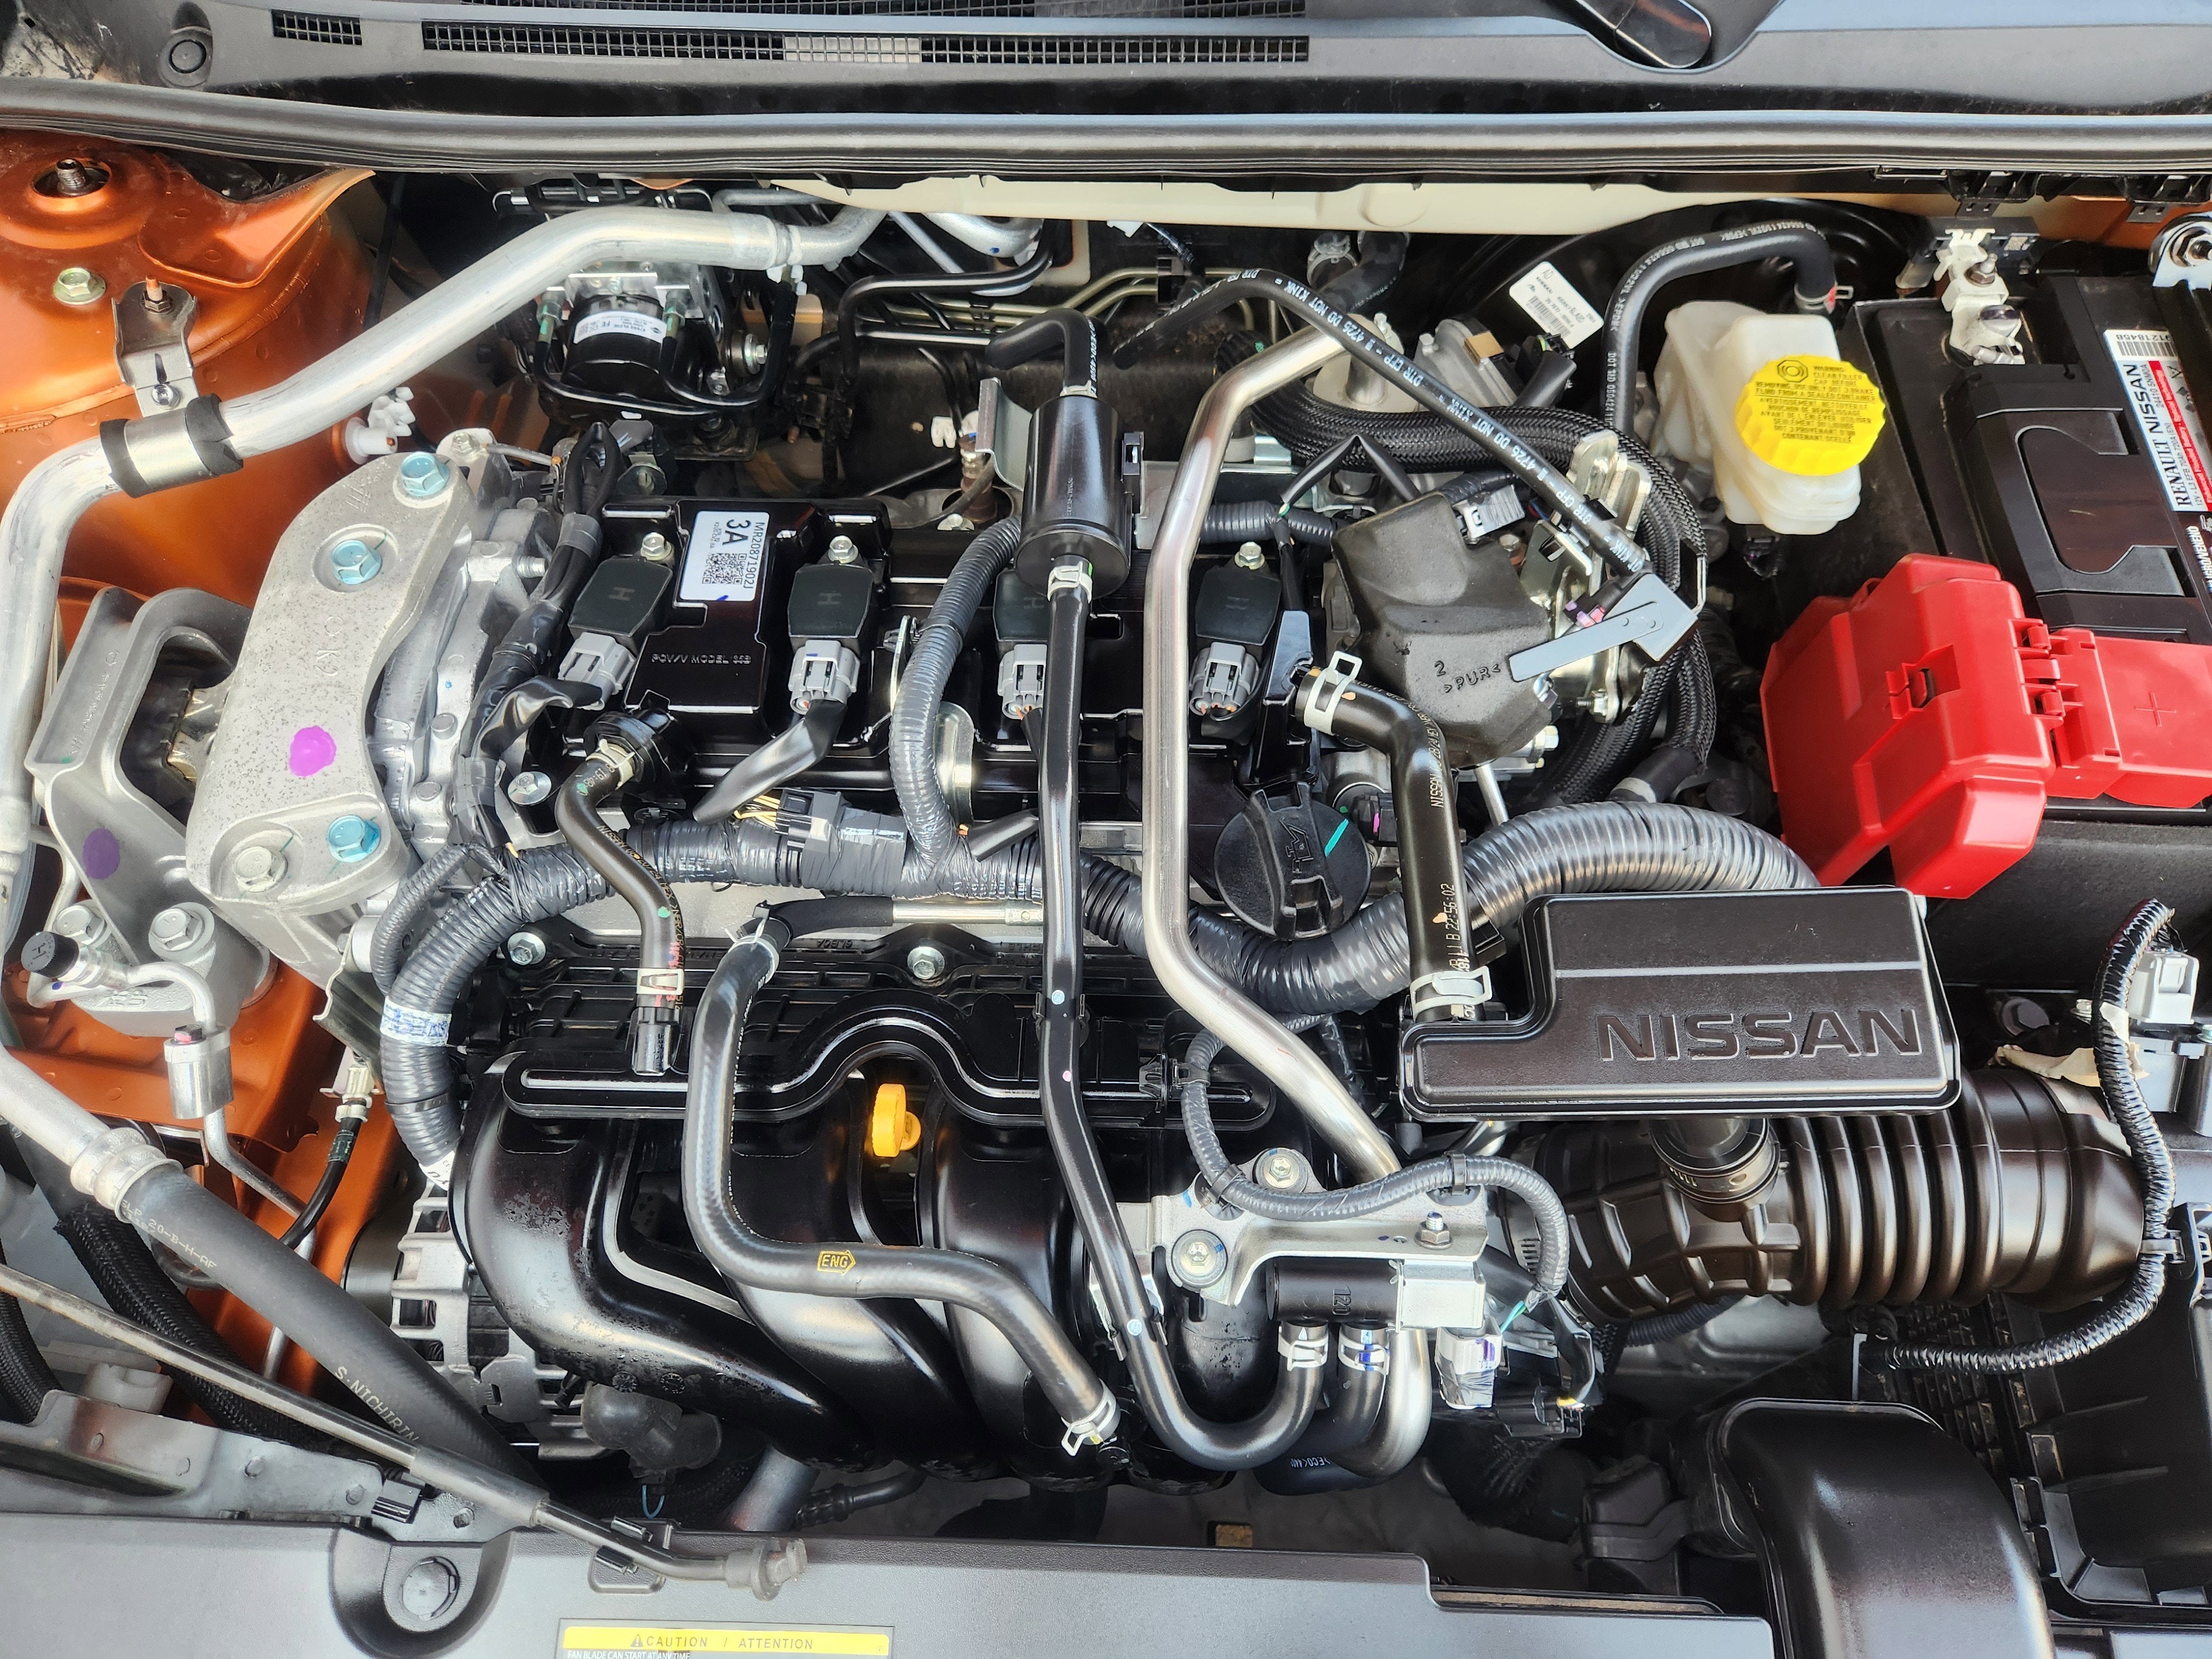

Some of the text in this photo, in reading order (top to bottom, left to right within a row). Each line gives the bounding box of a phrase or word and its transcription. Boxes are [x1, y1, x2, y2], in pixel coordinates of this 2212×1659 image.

[1284, 280, 1310, 302] KINK
[1309, 296, 1329, 316] NOT
[1327, 310, 1343, 327] DO
[1384, 354, 1405, 372] CFP
[1403, 367, 1424, 387] DTR
[2123, 364, 2163, 434] NISSAN
[1472, 418, 1494, 438] NOT
[1494, 432, 1511, 450] DO
[1511, 448, 1536, 471] 4726
[2152, 439, 2193, 507] RENAULT
[1556, 490, 1575, 508] CFP
[722, 519, 752, 546] 3A
[743, 522, 765, 589] MR20871902J
[1434, 660, 1446, 677] 2
[1430, 774, 1444, 808] NISSAN
[597, 825, 627, 848] NISSAN
[1441, 883, 1459, 931] 22:56:02
[1595, 1009, 1922, 1061] NISSAN
[822, 1254, 848, 1267] ENG
[646, 1636, 708, 1647] CAUTION
[739, 1638, 813, 1650] ATTENTION
[568, 1650, 581, 1659] FAN
[583, 1650, 606, 1659] BLADE
[608, 1651, 623, 1659] CAN
